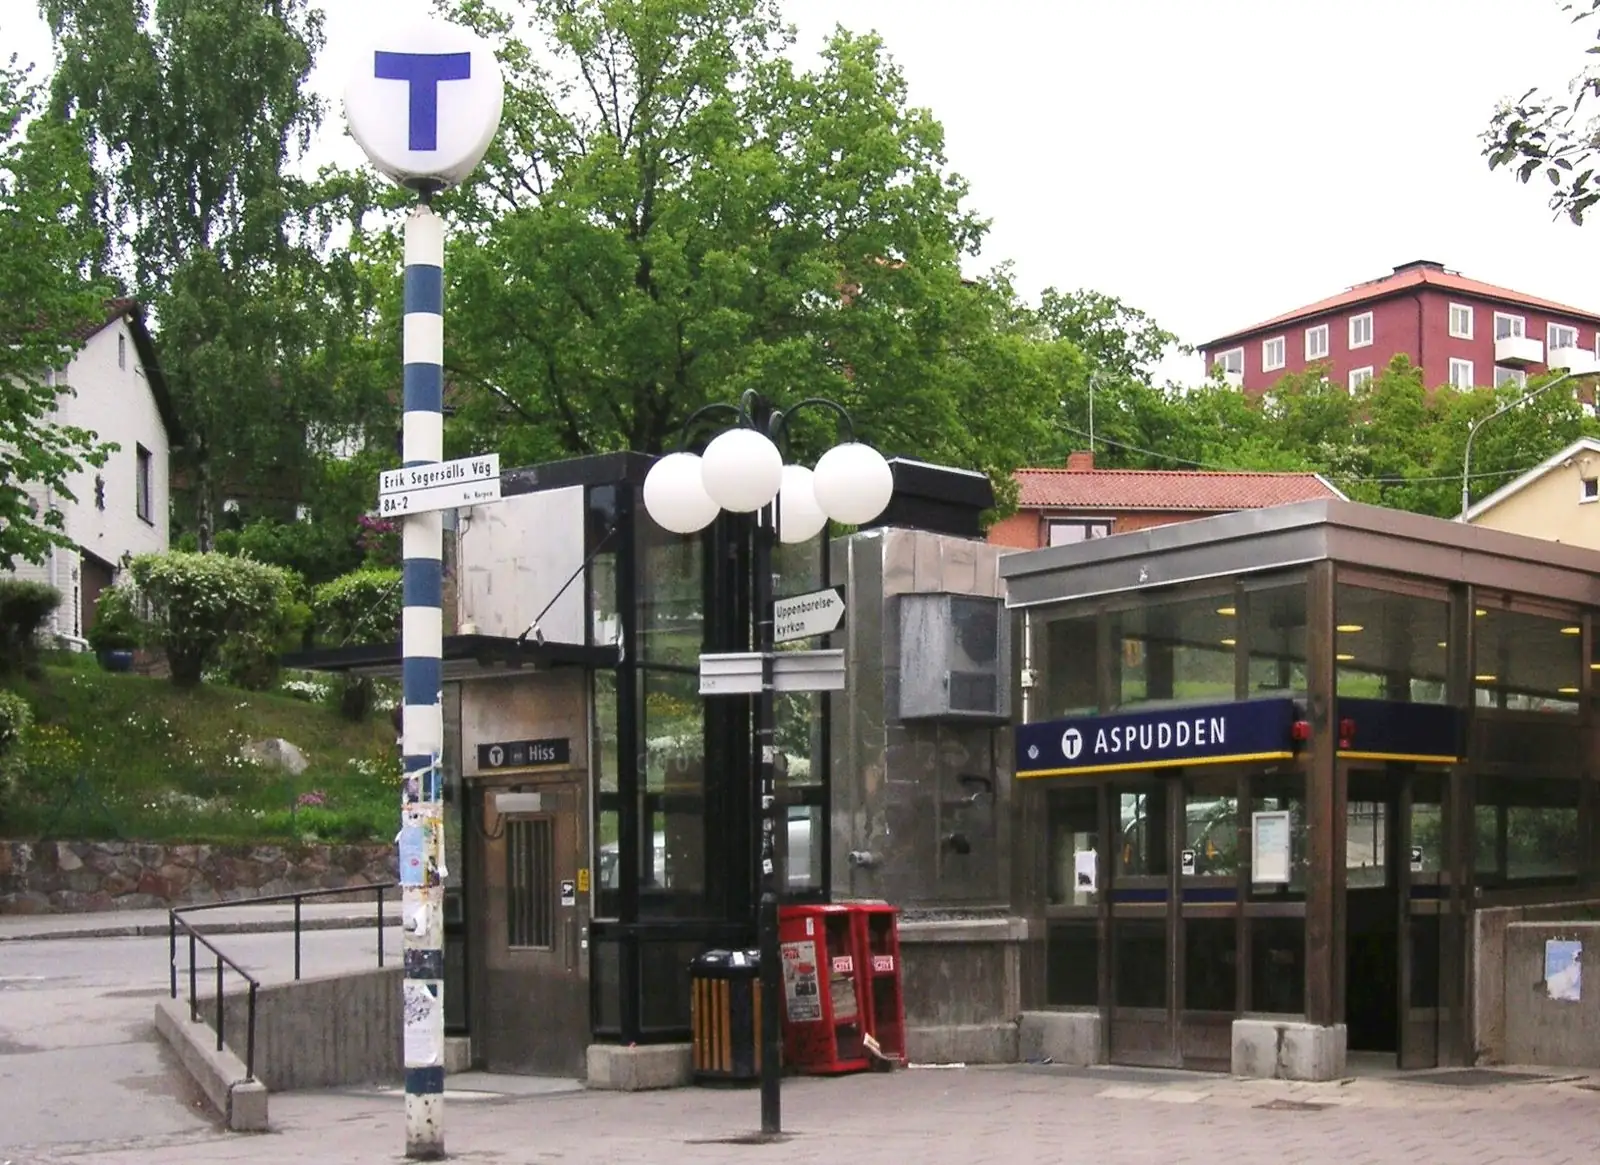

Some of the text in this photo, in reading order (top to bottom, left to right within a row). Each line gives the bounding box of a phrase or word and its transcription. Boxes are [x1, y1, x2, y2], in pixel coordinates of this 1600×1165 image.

[374, 50, 471, 151] T
[384, 473, 405, 488] Erik
[472, 461, 491, 476] Väg
[384, 496, 409, 512] 8A-2
[776, 596, 835, 619] Uppenbarelse-
[776, 620, 805, 637] kyrkan
[1094, 717, 1226, 754] ASPUDDEN
[529, 744, 555, 761] Hiss
